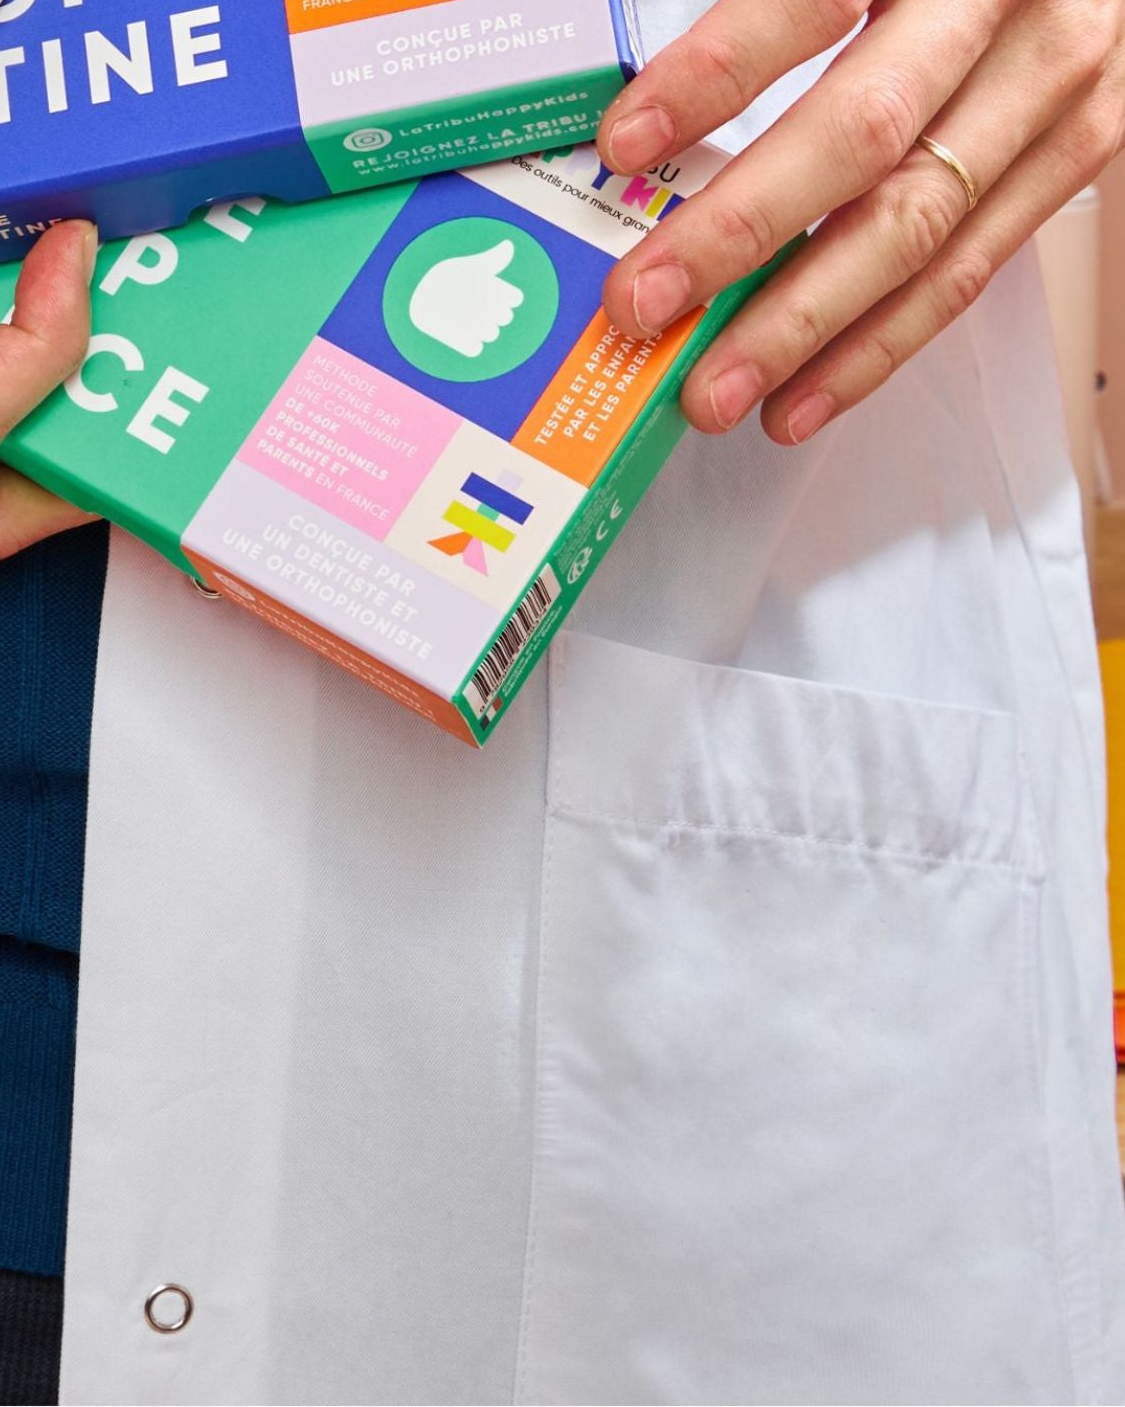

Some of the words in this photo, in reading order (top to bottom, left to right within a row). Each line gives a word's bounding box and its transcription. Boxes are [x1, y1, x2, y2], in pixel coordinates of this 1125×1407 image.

[330, 64, 375, 87] UNE
[383, 22, 577, 77] ORTHOPHONISTE
[376, 23, 473, 56] CONÇUE
[480, 13, 523, 35] PAR
[351, 136, 480, 170] REJOIGNEZ
[486, 127, 517, 141] LA
[522, 113, 588, 134] TRIBU
[398, 92, 589, 138] LaTribuHappyKids
[511, 156, 531, 172] Des
[534, 168, 563, 188] outils
[562, 183, 589, 202] pour
[589, 196, 627, 221] mieux
[284, 397, 306, 415] DE
[306, 409, 340, 434] +60K
[294, 384, 322, 404] UNE
[323, 397, 419, 458] COMMUNAUTÉ
[303, 370, 373, 415] SOUTENUE
[375, 406, 402, 430] PAR
[534, 394, 575, 446] TESTÉE
[570, 374, 588, 394] ET
[563, 409, 589, 438] PAR
[584, 380, 608, 408] LES
[582, 423, 602, 443] ET
[597, 394, 620, 421] LES
[266, 425, 287, 443] DE
[286, 435, 330, 468] SANTÉ
[330, 461, 348, 478] ET
[275, 412, 389, 482] PROFESSIONNELS
[256, 439, 314, 479] PARENTS
[315, 473, 336, 492] EN
[336, 482, 390, 522] FRANCE
[262, 524, 292, 550] UN
[293, 543, 394, 612] DENTISTE
[393, 597, 420, 623] ET
[289, 514, 374, 572] CONÇUE
[375, 564, 417, 596] PAR
[223, 528, 263, 563] UNE
[266, 553, 435, 660] ORTHOPHONISTE
